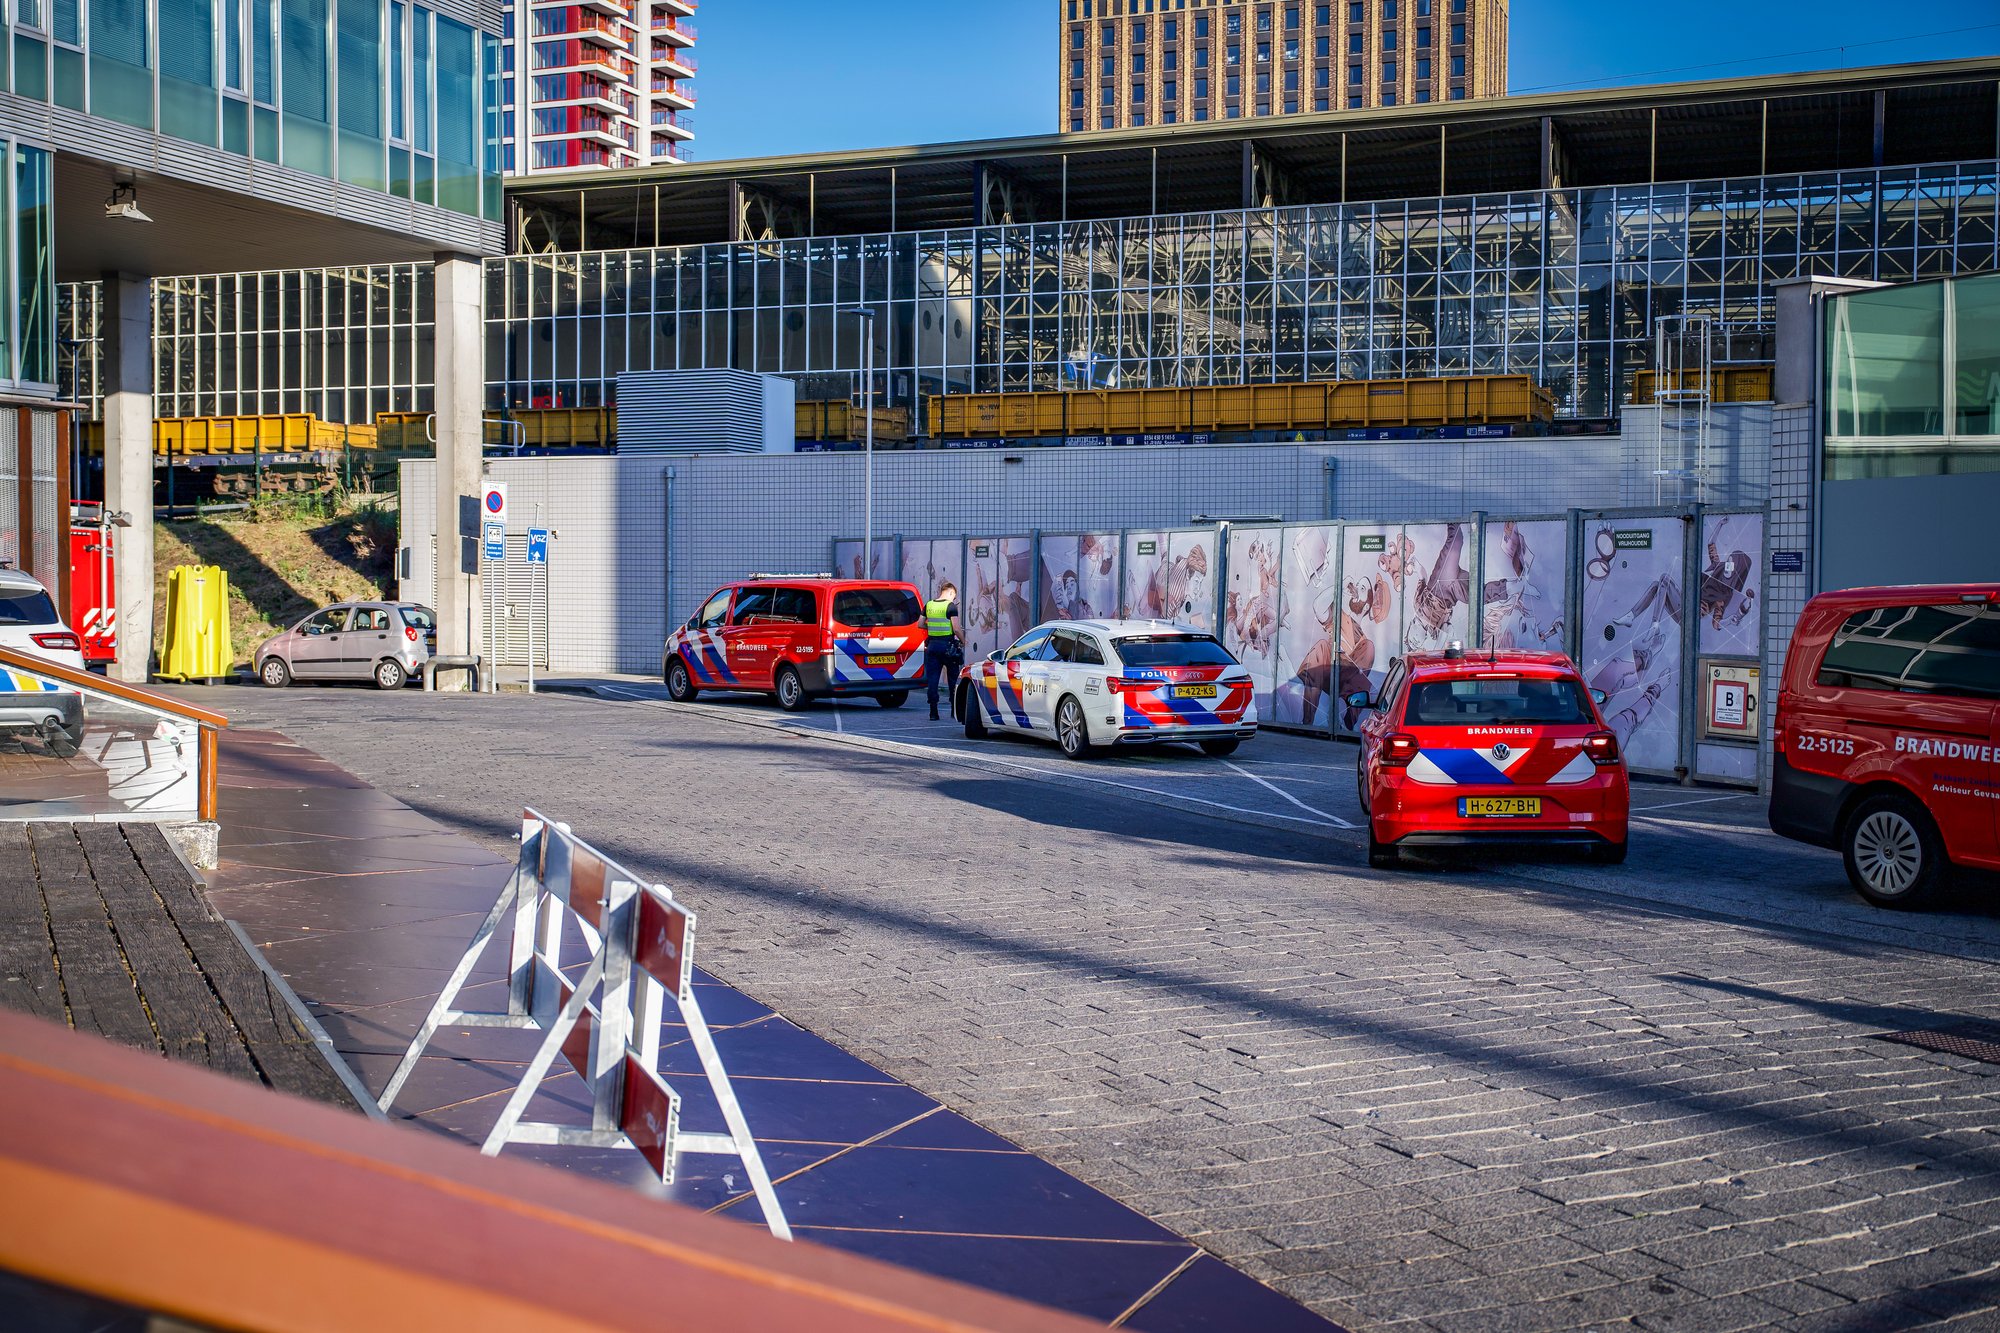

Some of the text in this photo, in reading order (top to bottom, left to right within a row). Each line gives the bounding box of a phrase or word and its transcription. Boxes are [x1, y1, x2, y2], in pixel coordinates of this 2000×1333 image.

[530, 534, 547, 543] VGZ
[1141, 670, 1178, 678] POLITIE
[1177, 687, 1214, 696] P-422-KS
[1726, 691, 1734, 707] B
[1467, 727, 1533, 735] BRANDWEER
[1797, 735, 1854, 755] 22-5125
[1895, 736, 2000, 763] BRANDWEE
[1933, 783, 1971, 796] Adviseur
[1471, 799, 1536, 812] H-627-BH
